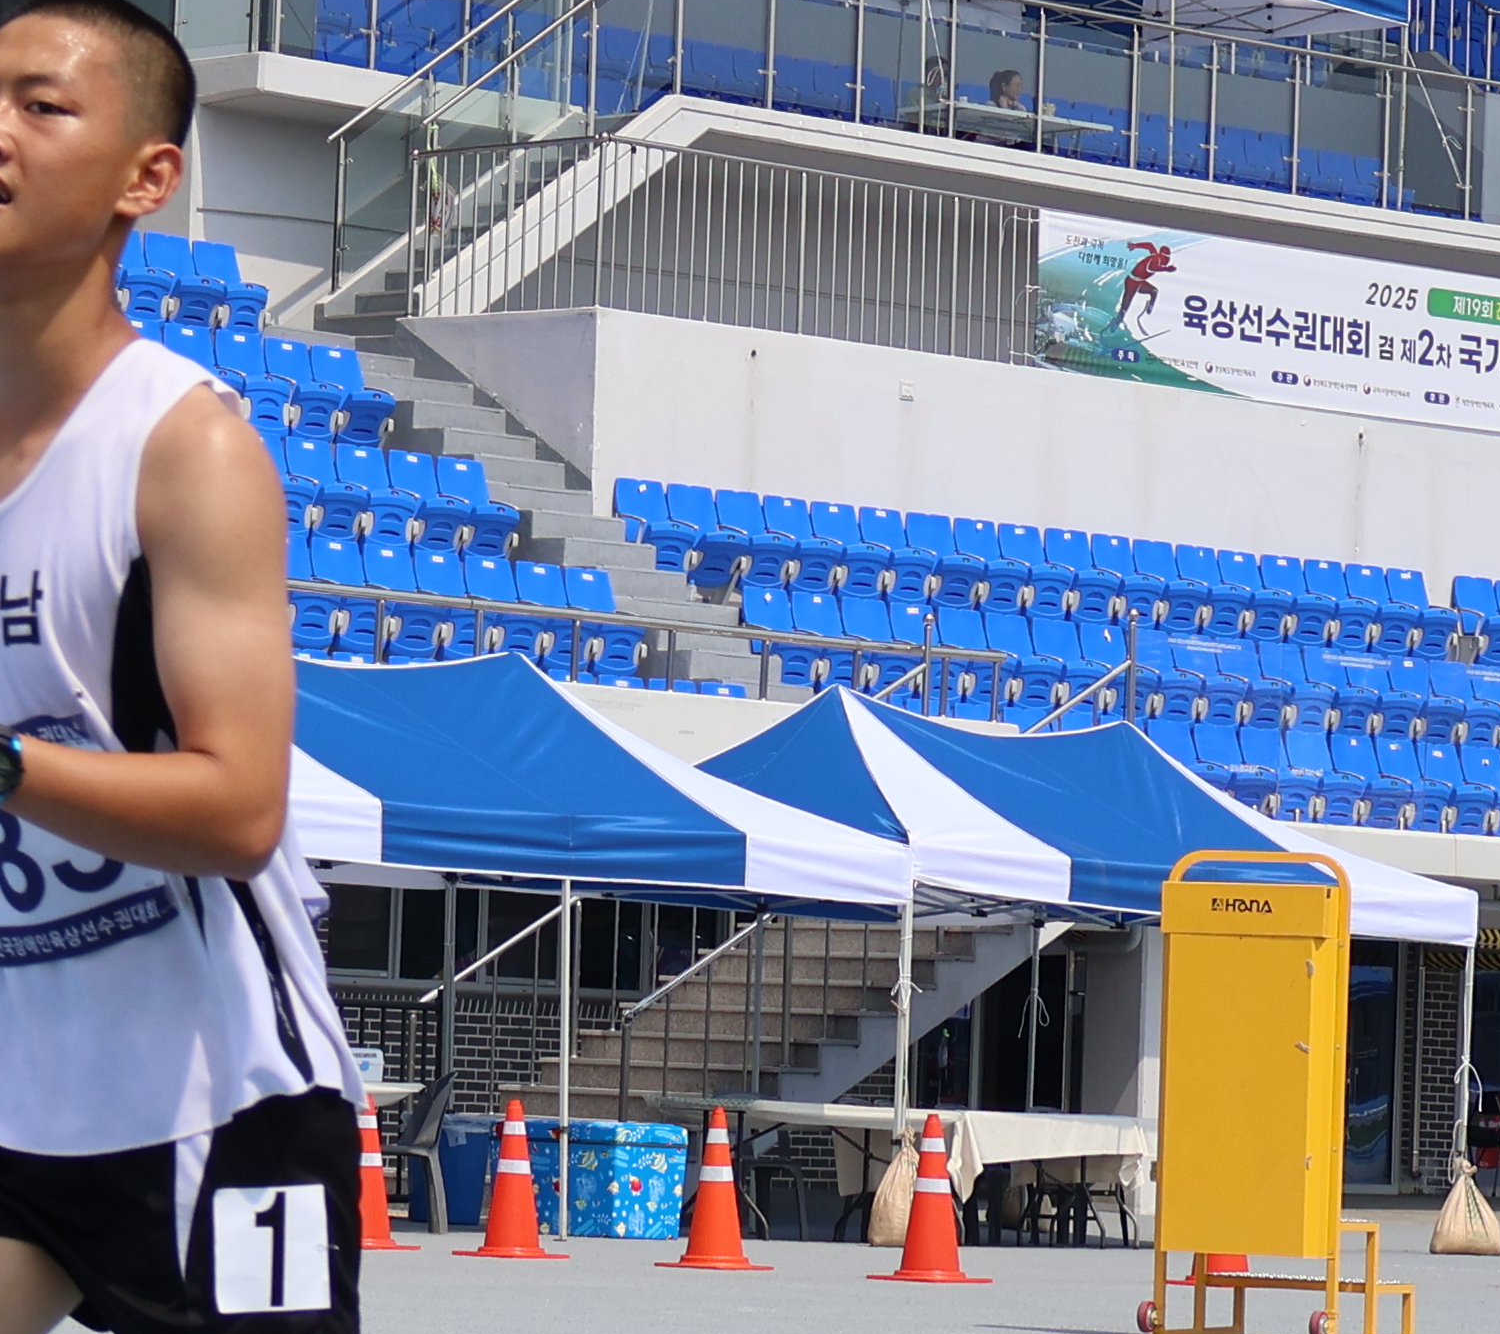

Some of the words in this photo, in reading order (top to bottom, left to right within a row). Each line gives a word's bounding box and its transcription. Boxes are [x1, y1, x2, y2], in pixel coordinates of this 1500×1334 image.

[1183, 295, 1370, 358] 육상선수권대회
[1379, 335, 1393, 361] 겸
[1401, 329, 1452, 368] 제2차
[1366, 283, 1418, 311] 2025
[1453, 296, 1493, 319] 제19회
[255, 1191, 284, 1307] 1
